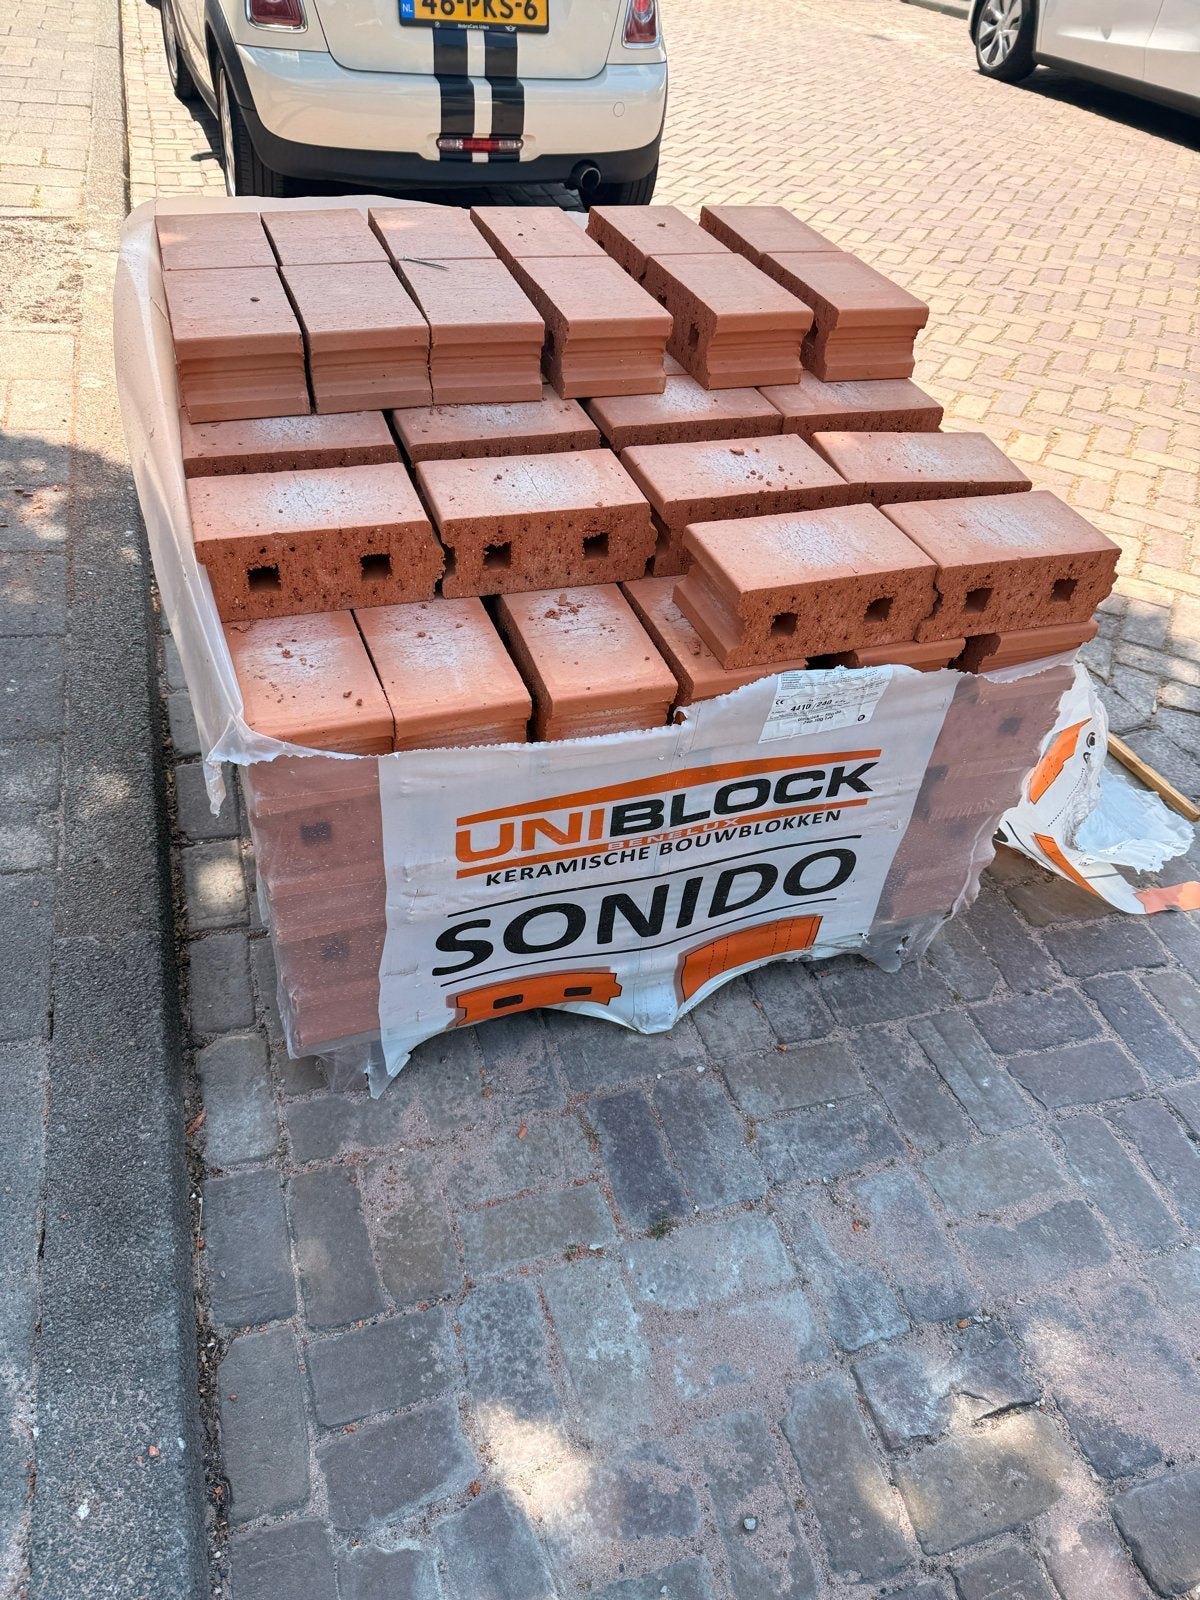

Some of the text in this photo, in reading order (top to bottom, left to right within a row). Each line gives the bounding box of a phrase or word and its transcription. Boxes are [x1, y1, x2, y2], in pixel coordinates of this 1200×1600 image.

[402, 3, 413, 12] NL
[421, 0, 538, 20] 46-PKS-6
[455, 761, 879, 863] UNIBLOCK
[606, 817, 740, 851] BENELUX
[485, 809, 842, 887] KERAMISCHE BOUWBLOKKEN
[431, 848, 857, 977] SONIDO
